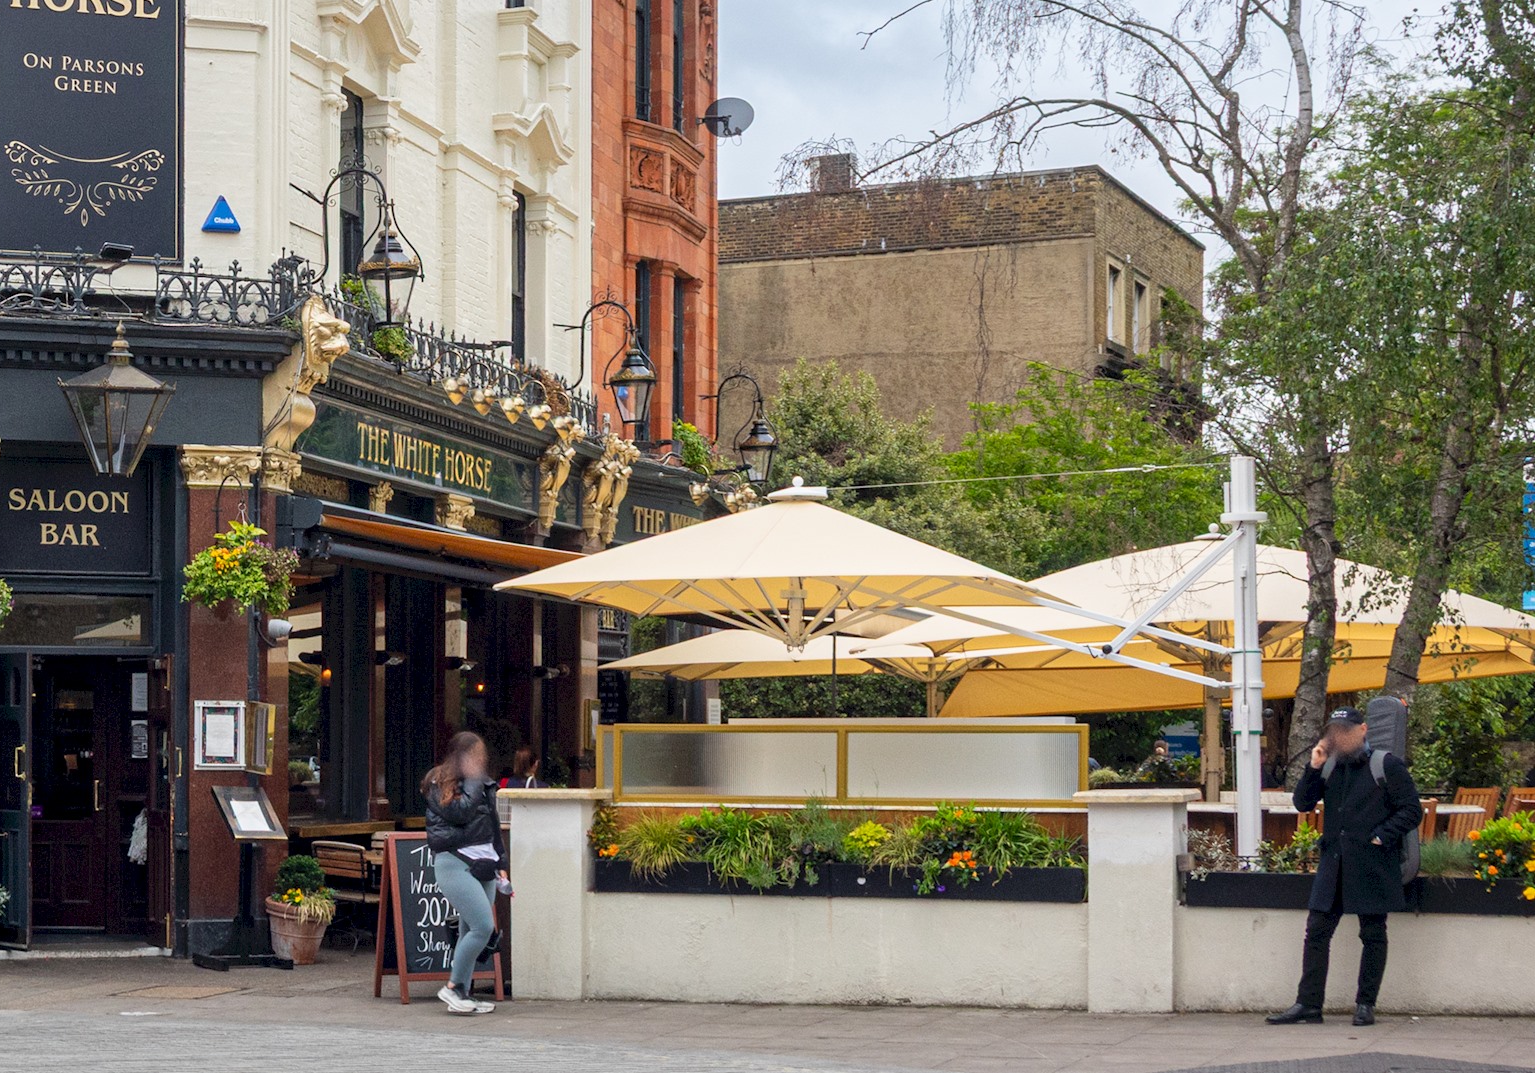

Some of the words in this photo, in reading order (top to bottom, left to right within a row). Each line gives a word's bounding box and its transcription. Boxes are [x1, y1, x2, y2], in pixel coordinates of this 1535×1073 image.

[357, 421, 390, 466] THE
[393, 431, 442, 478] WHITE
[444, 447, 493, 493] HORSE
[7, 487, 130, 514] SALOON
[633, 505, 665, 535] THE
[39, 523, 101, 547] BAR
[410, 843, 435, 867] Th
